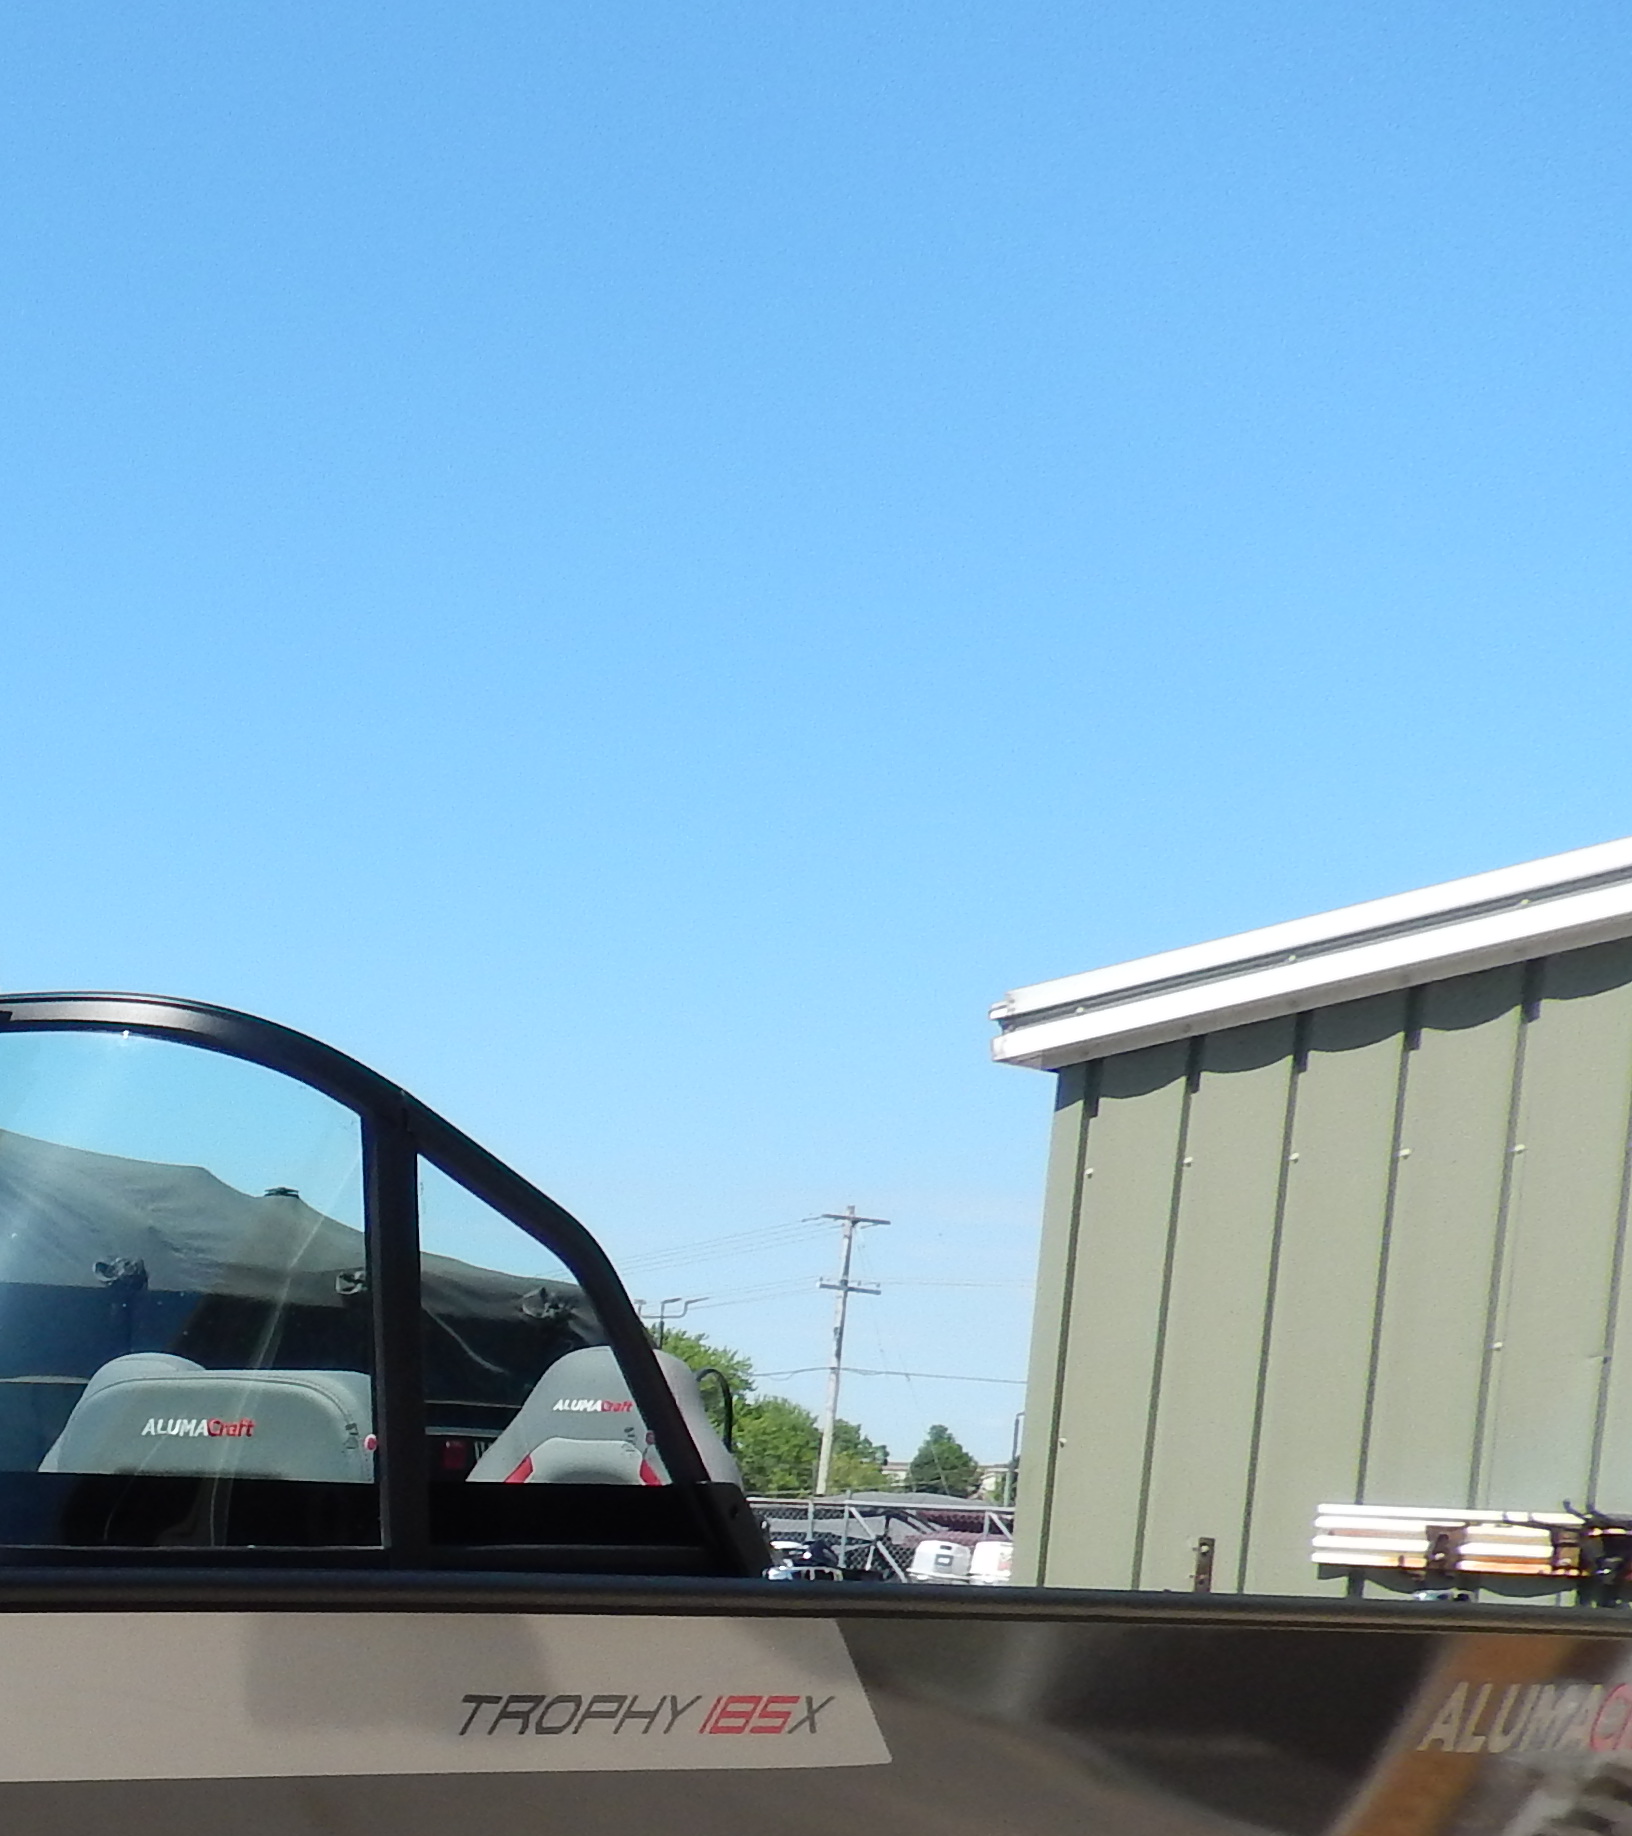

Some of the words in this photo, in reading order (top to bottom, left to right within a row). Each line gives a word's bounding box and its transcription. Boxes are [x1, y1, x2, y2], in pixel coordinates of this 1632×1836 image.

[551, 1398, 634, 1413] ALUMACraft
[141, 1417, 255, 1438] ALUMACraft
[458, 1694, 702, 1736] TROPHY
[698, 1694, 836, 1735] 185X
